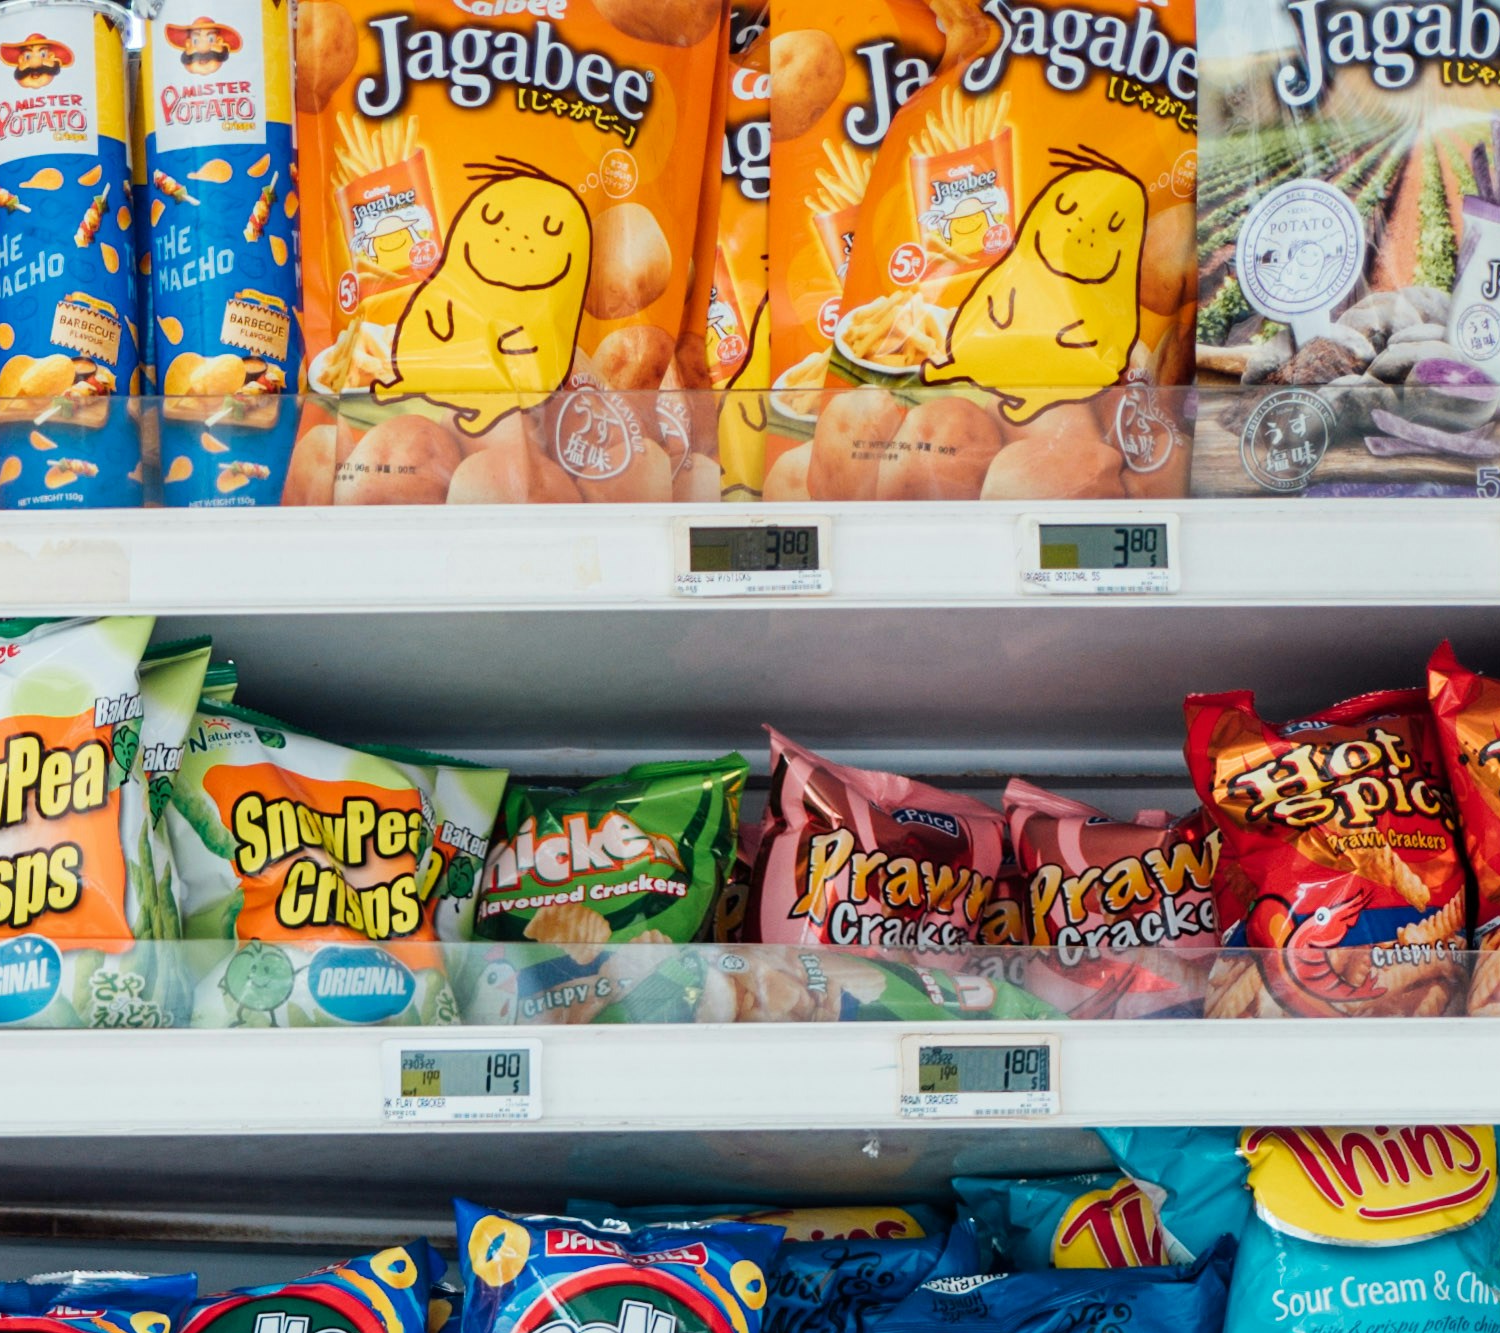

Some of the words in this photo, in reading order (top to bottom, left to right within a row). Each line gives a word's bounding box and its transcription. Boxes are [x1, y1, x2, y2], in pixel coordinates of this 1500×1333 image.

[356, 14, 655, 120] Jagabee
[15, 94, 85, 113] MISTER
[1269, 213, 1334, 233] POTATO
[58, 311, 122, 345] BARBECUE
[588, 873, 687, 901] Crackers
